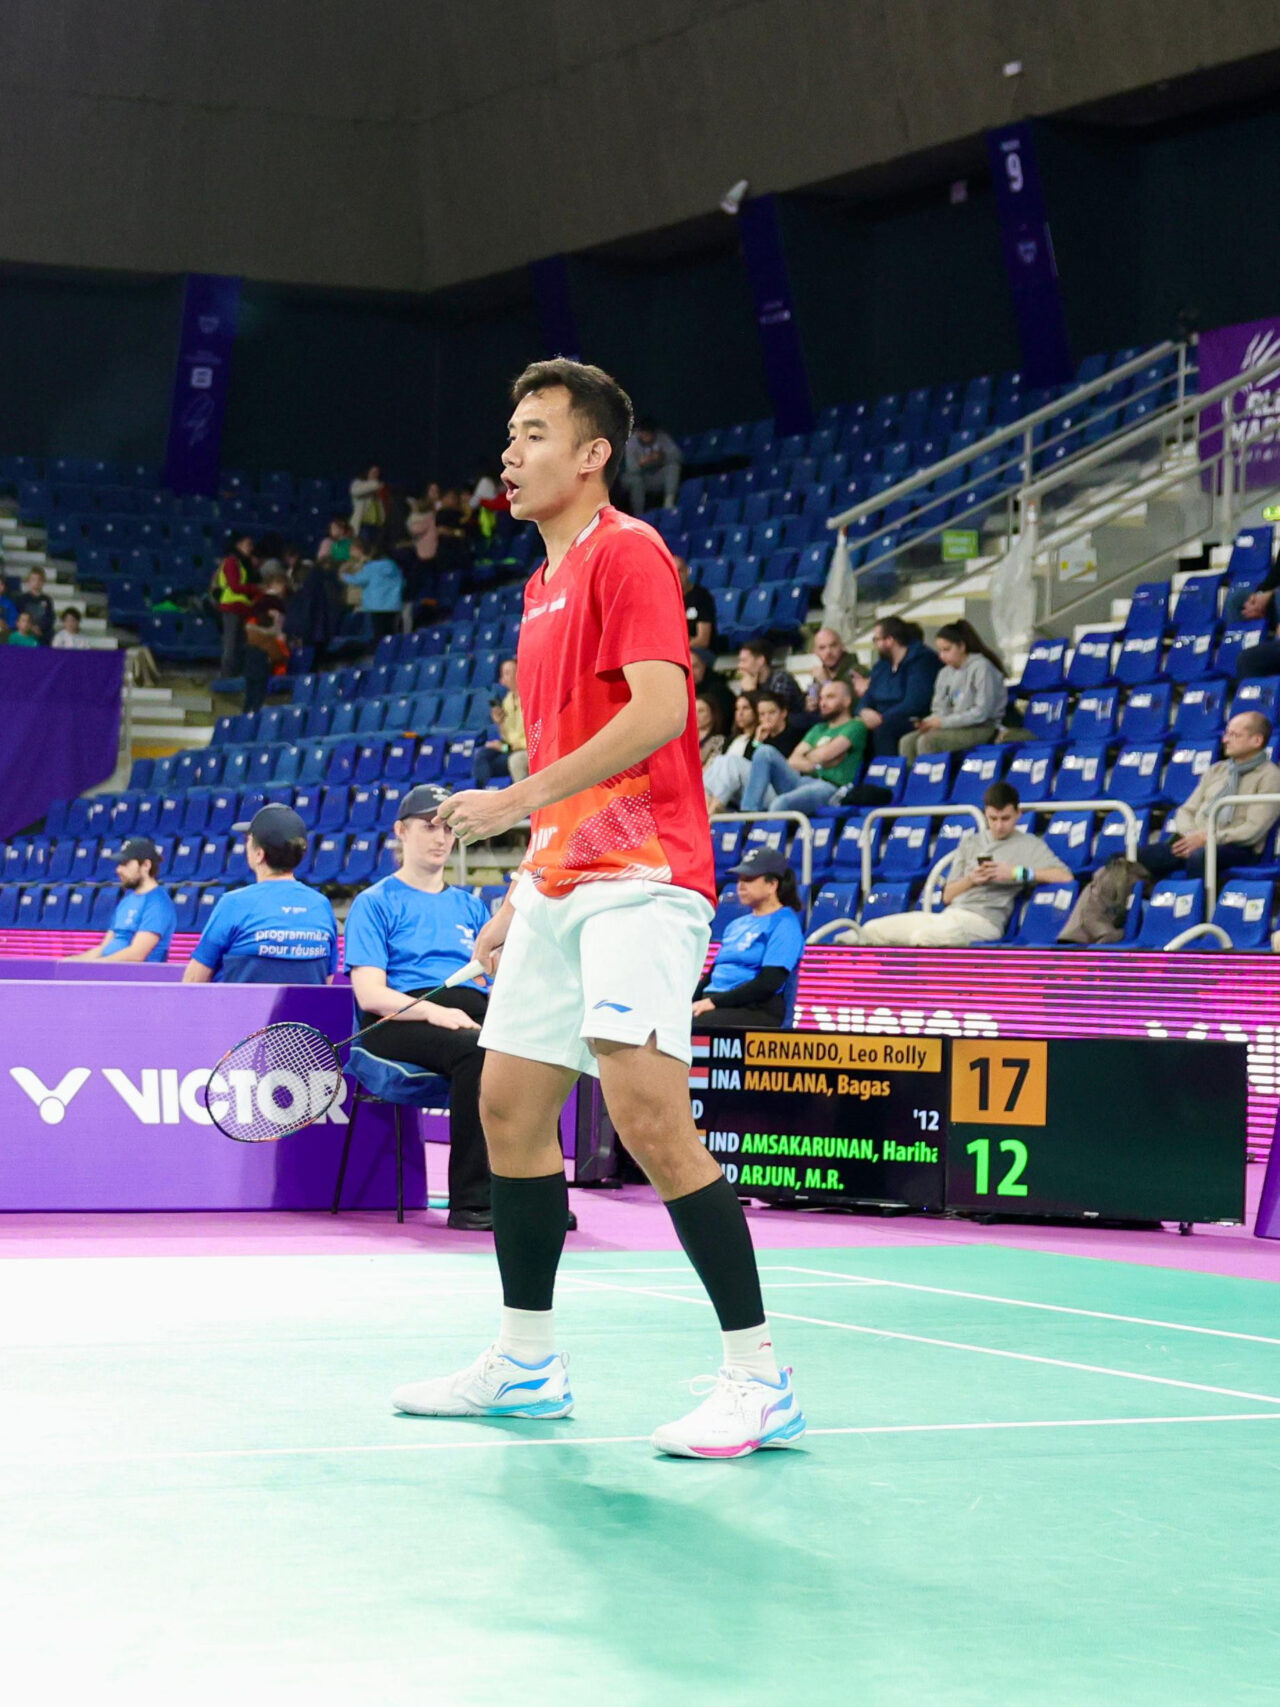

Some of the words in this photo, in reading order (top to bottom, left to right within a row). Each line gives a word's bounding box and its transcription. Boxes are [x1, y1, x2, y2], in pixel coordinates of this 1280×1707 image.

[1006, 152, 1023, 192] 9
[258, 944, 288, 956] pour
[712, 1038, 742, 1059] INA
[746, 1039, 844, 1065] CARNANDO,
[849, 1045, 878, 1063] Leo
[883, 1045, 927, 1069] Rolly
[101, 1068, 350, 1125] VICTOR
[711, 1069, 741, 1091] INA
[744, 1071, 834, 1097] MAULANA,
[837, 1075, 891, 1101] Bagas
[969, 1058, 1031, 1112] 17
[709, 1131, 740, 1153] IND
[741, 1132, 879, 1164] AMSAKARUNAN,
[739, 1164, 802, 1190] ARJUN,
[804, 1168, 845, 1190] M.R.
[966, 1138, 1029, 1197] 12
